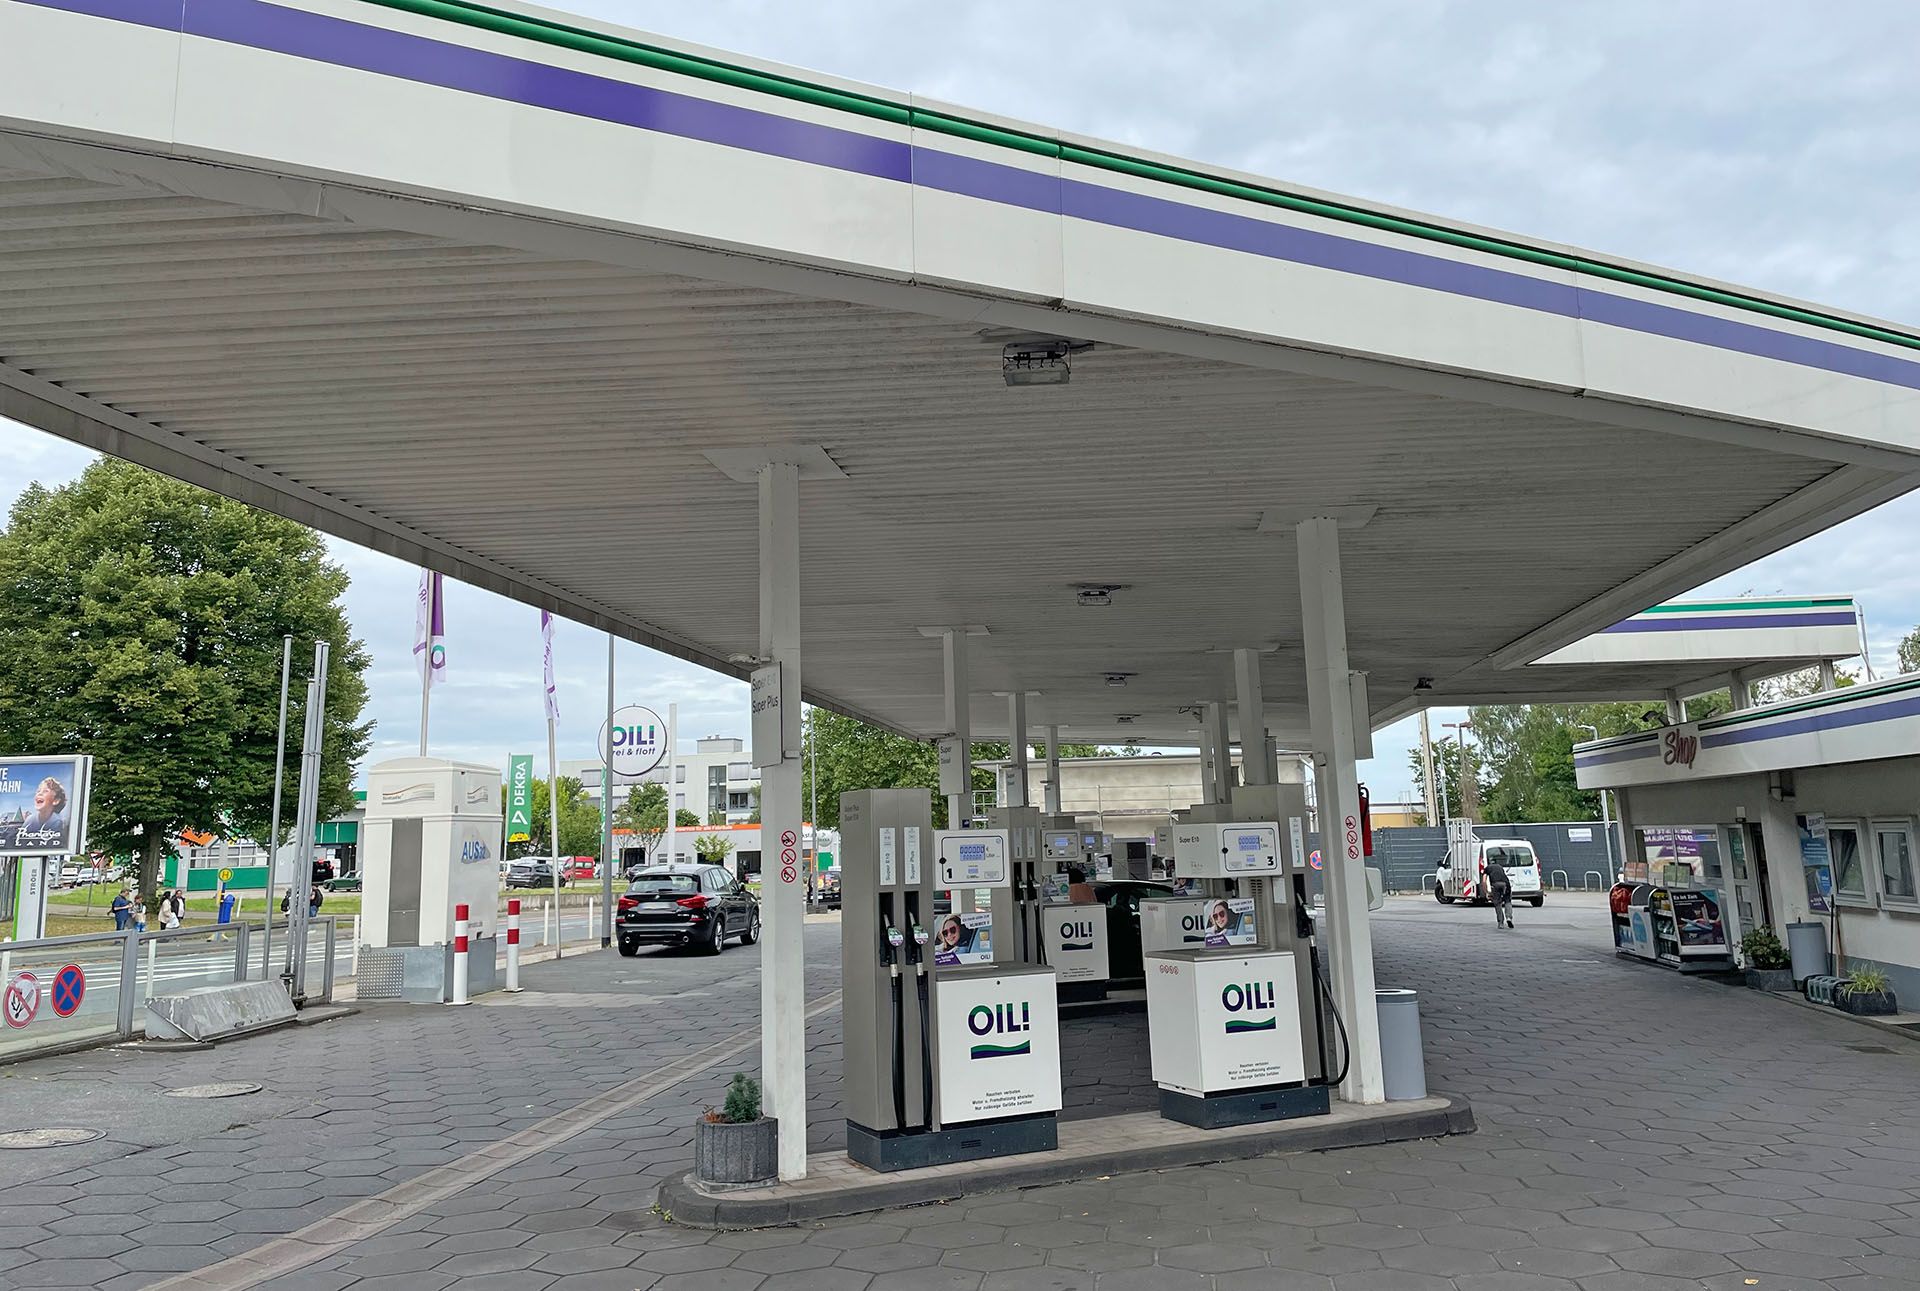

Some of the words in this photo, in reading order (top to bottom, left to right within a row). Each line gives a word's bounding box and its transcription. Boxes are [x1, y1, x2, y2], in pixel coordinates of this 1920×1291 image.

[613, 725, 655, 747] OIL!
[1664, 728, 1697, 769] Shop
[513, 761, 527, 806] DEKRA
[1267, 856, 1274, 866] 3
[946, 868, 953, 879] 1
[1060, 922, 1092, 939] OIL!
[1181, 915, 1205, 931] OIL
[1222, 981, 1275, 1012] OIL!
[968, 1001, 1030, 1036] OIL!
